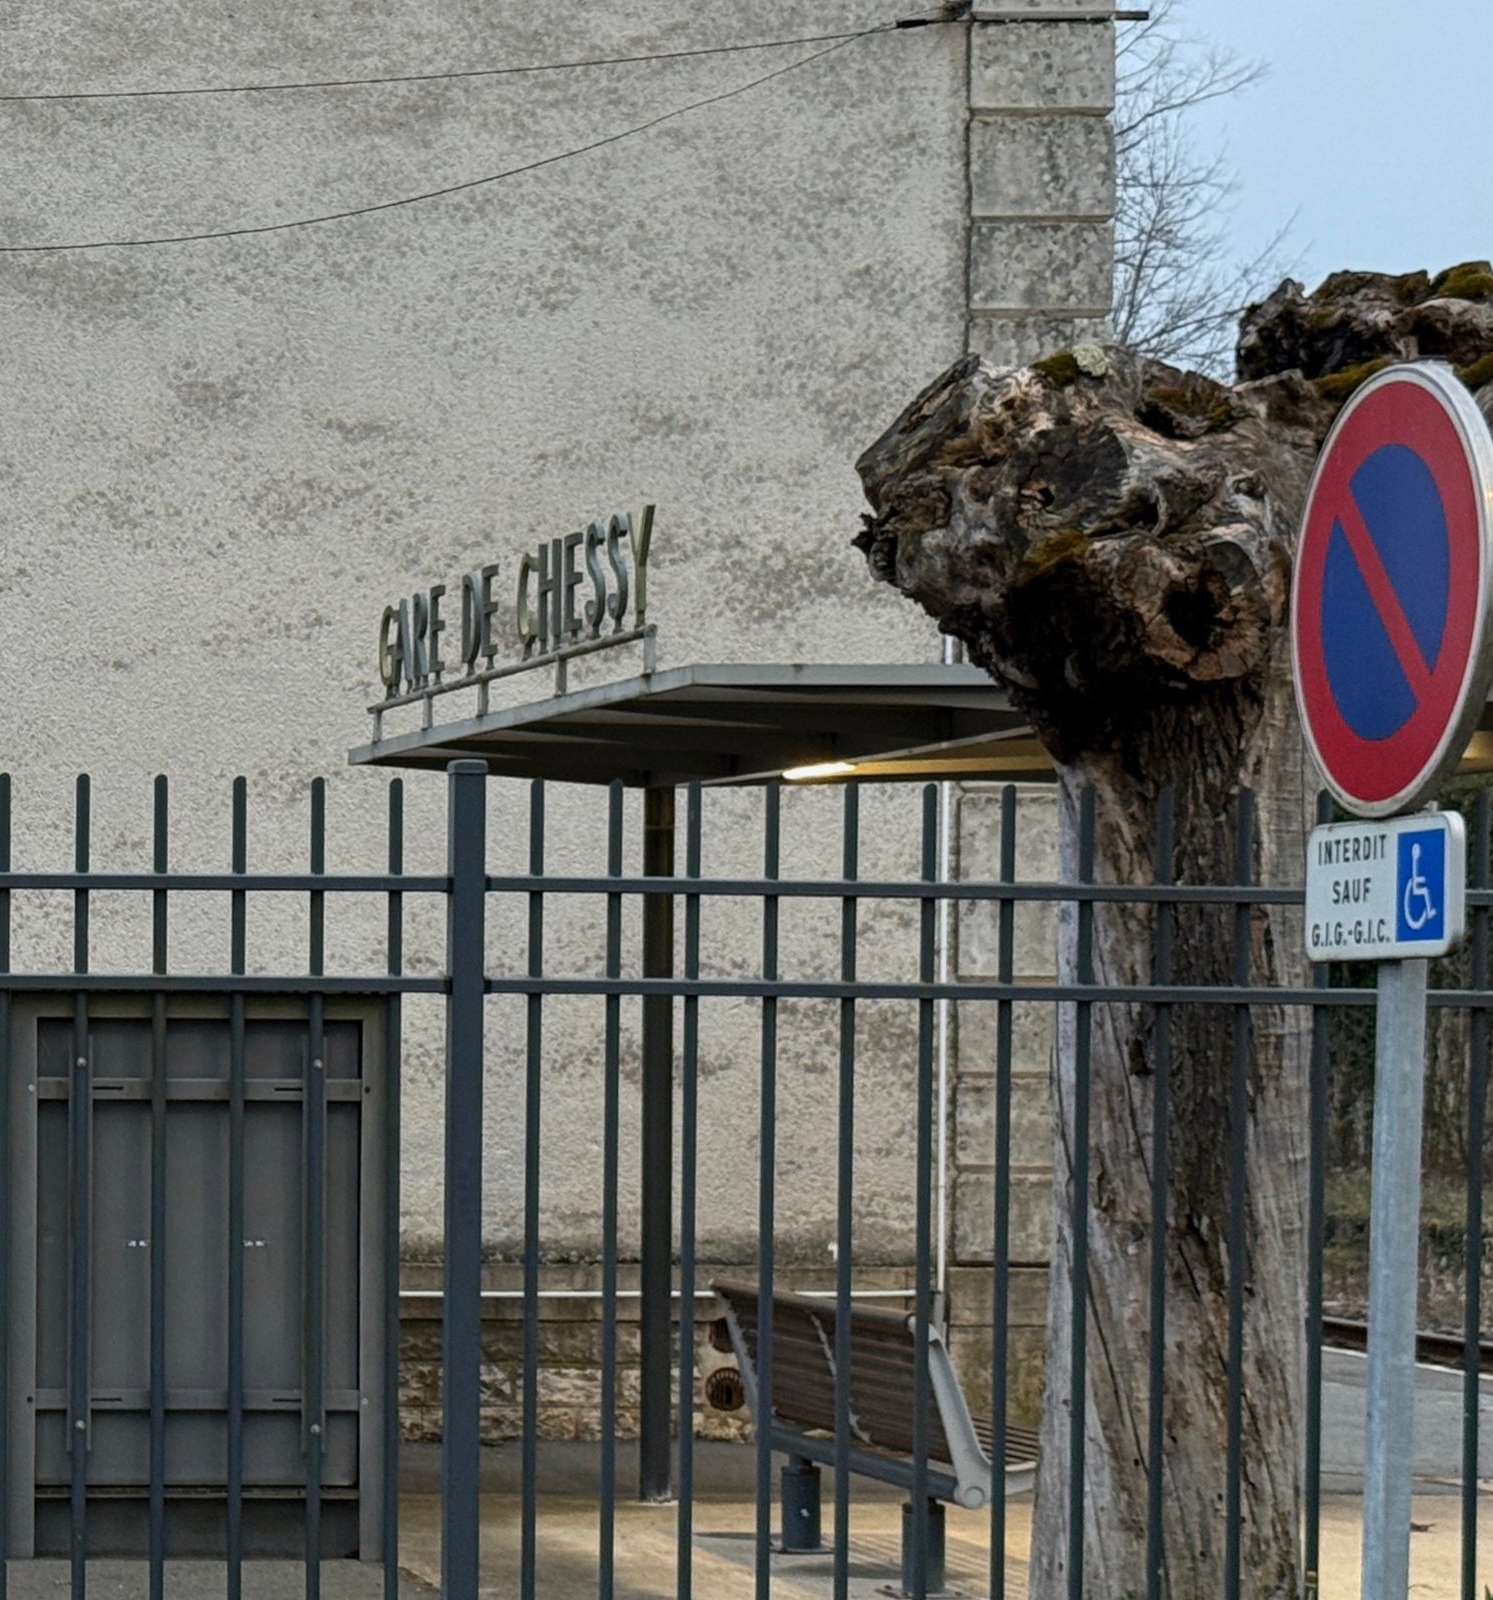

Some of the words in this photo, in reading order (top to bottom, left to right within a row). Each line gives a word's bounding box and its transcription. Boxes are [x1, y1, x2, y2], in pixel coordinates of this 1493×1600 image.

[378, 584, 447, 690] GARE
[461, 563, 500, 664] DE
[516, 503, 657, 647] CHESSY
[1317, 833, 1388, 866] INTERDIT
[1331, 876, 1372, 905] SAUF
[1311, 918, 1391, 948] G.I.G.-G.I.C.
